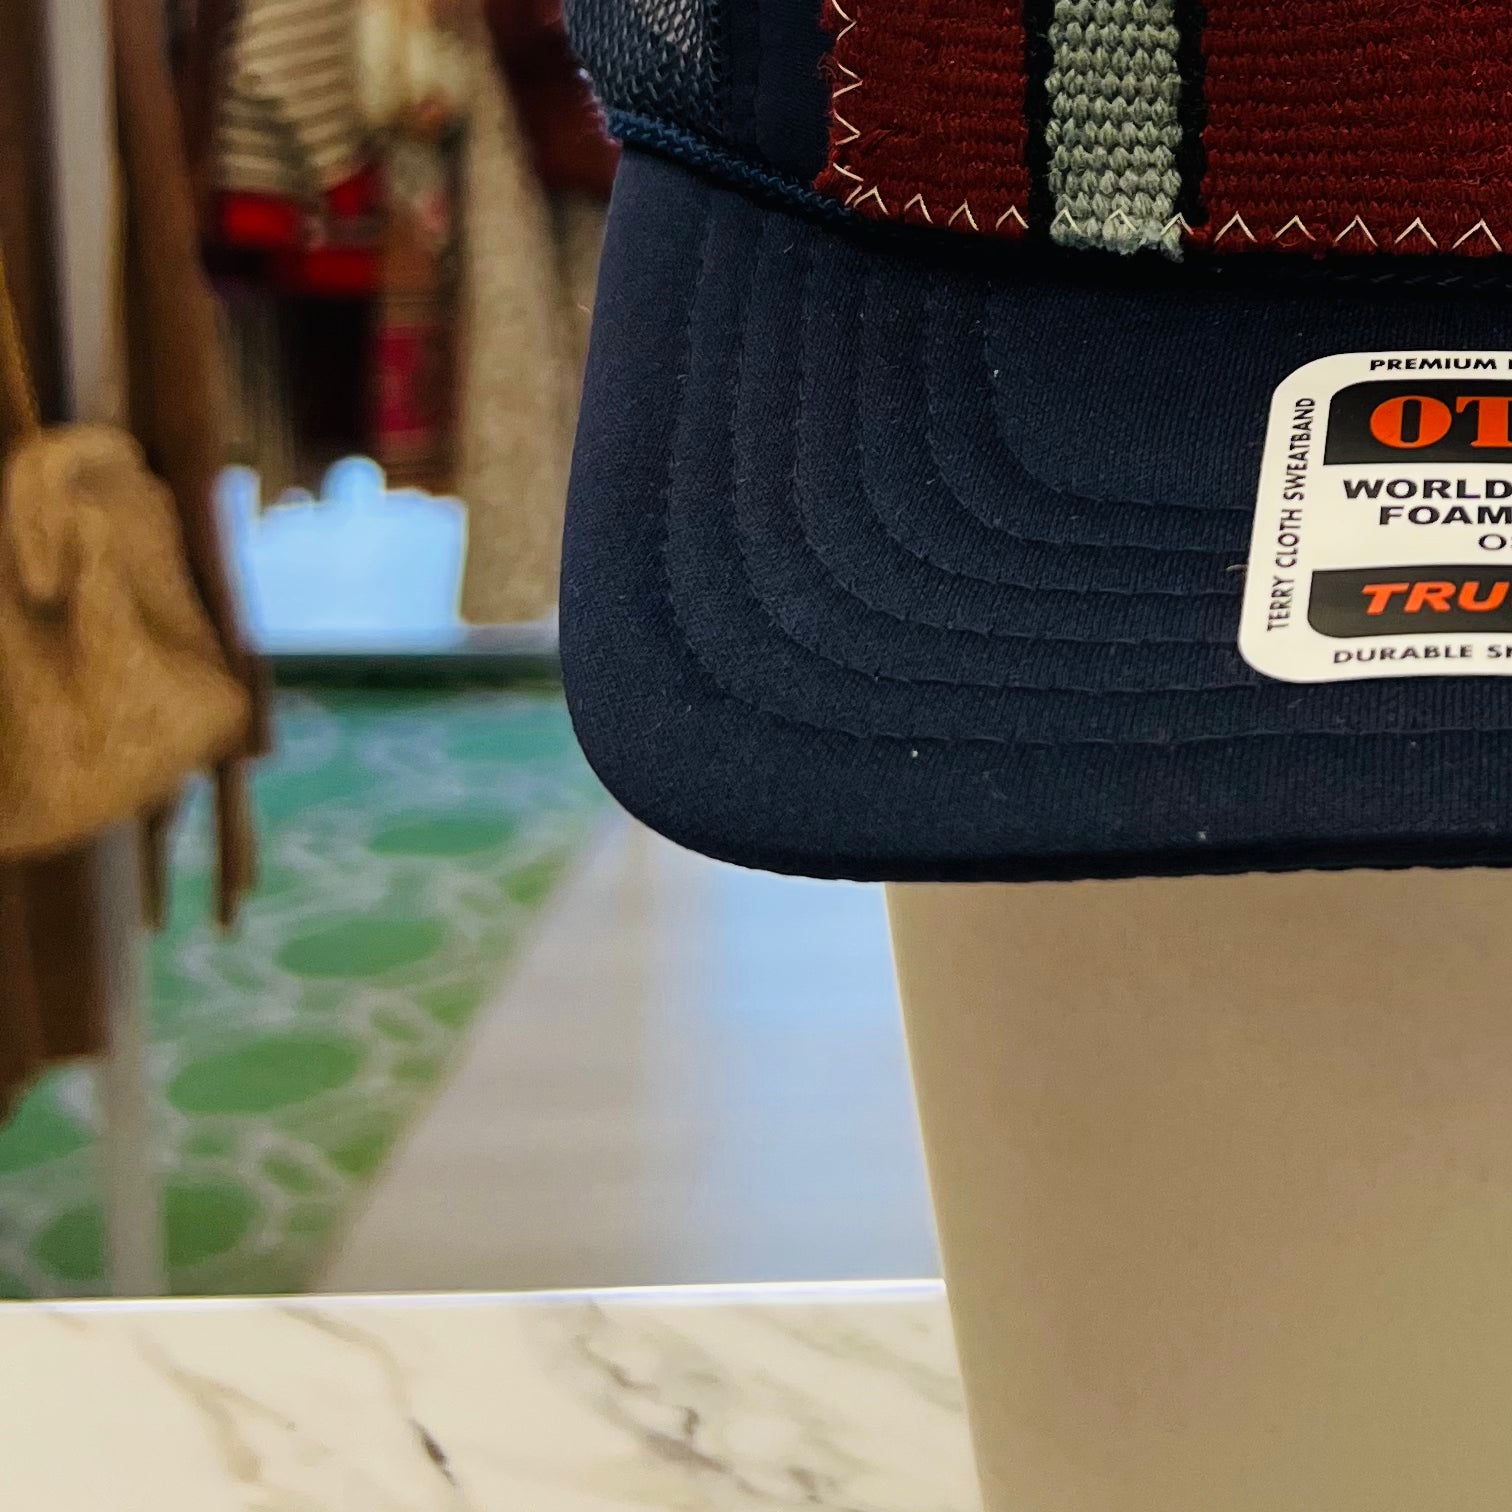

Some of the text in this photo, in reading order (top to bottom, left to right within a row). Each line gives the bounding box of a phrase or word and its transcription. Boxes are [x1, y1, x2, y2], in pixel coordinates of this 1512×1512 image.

[1370, 358, 1497, 370] PREMIUM
[1344, 479, 1512, 499] WORLD
[1267, 398, 1315, 631] TERRY CLOTH SWEATBAND
[1380, 506, 1512, 525] FOAM
[1334, 646, 1471, 663] DURABLE
